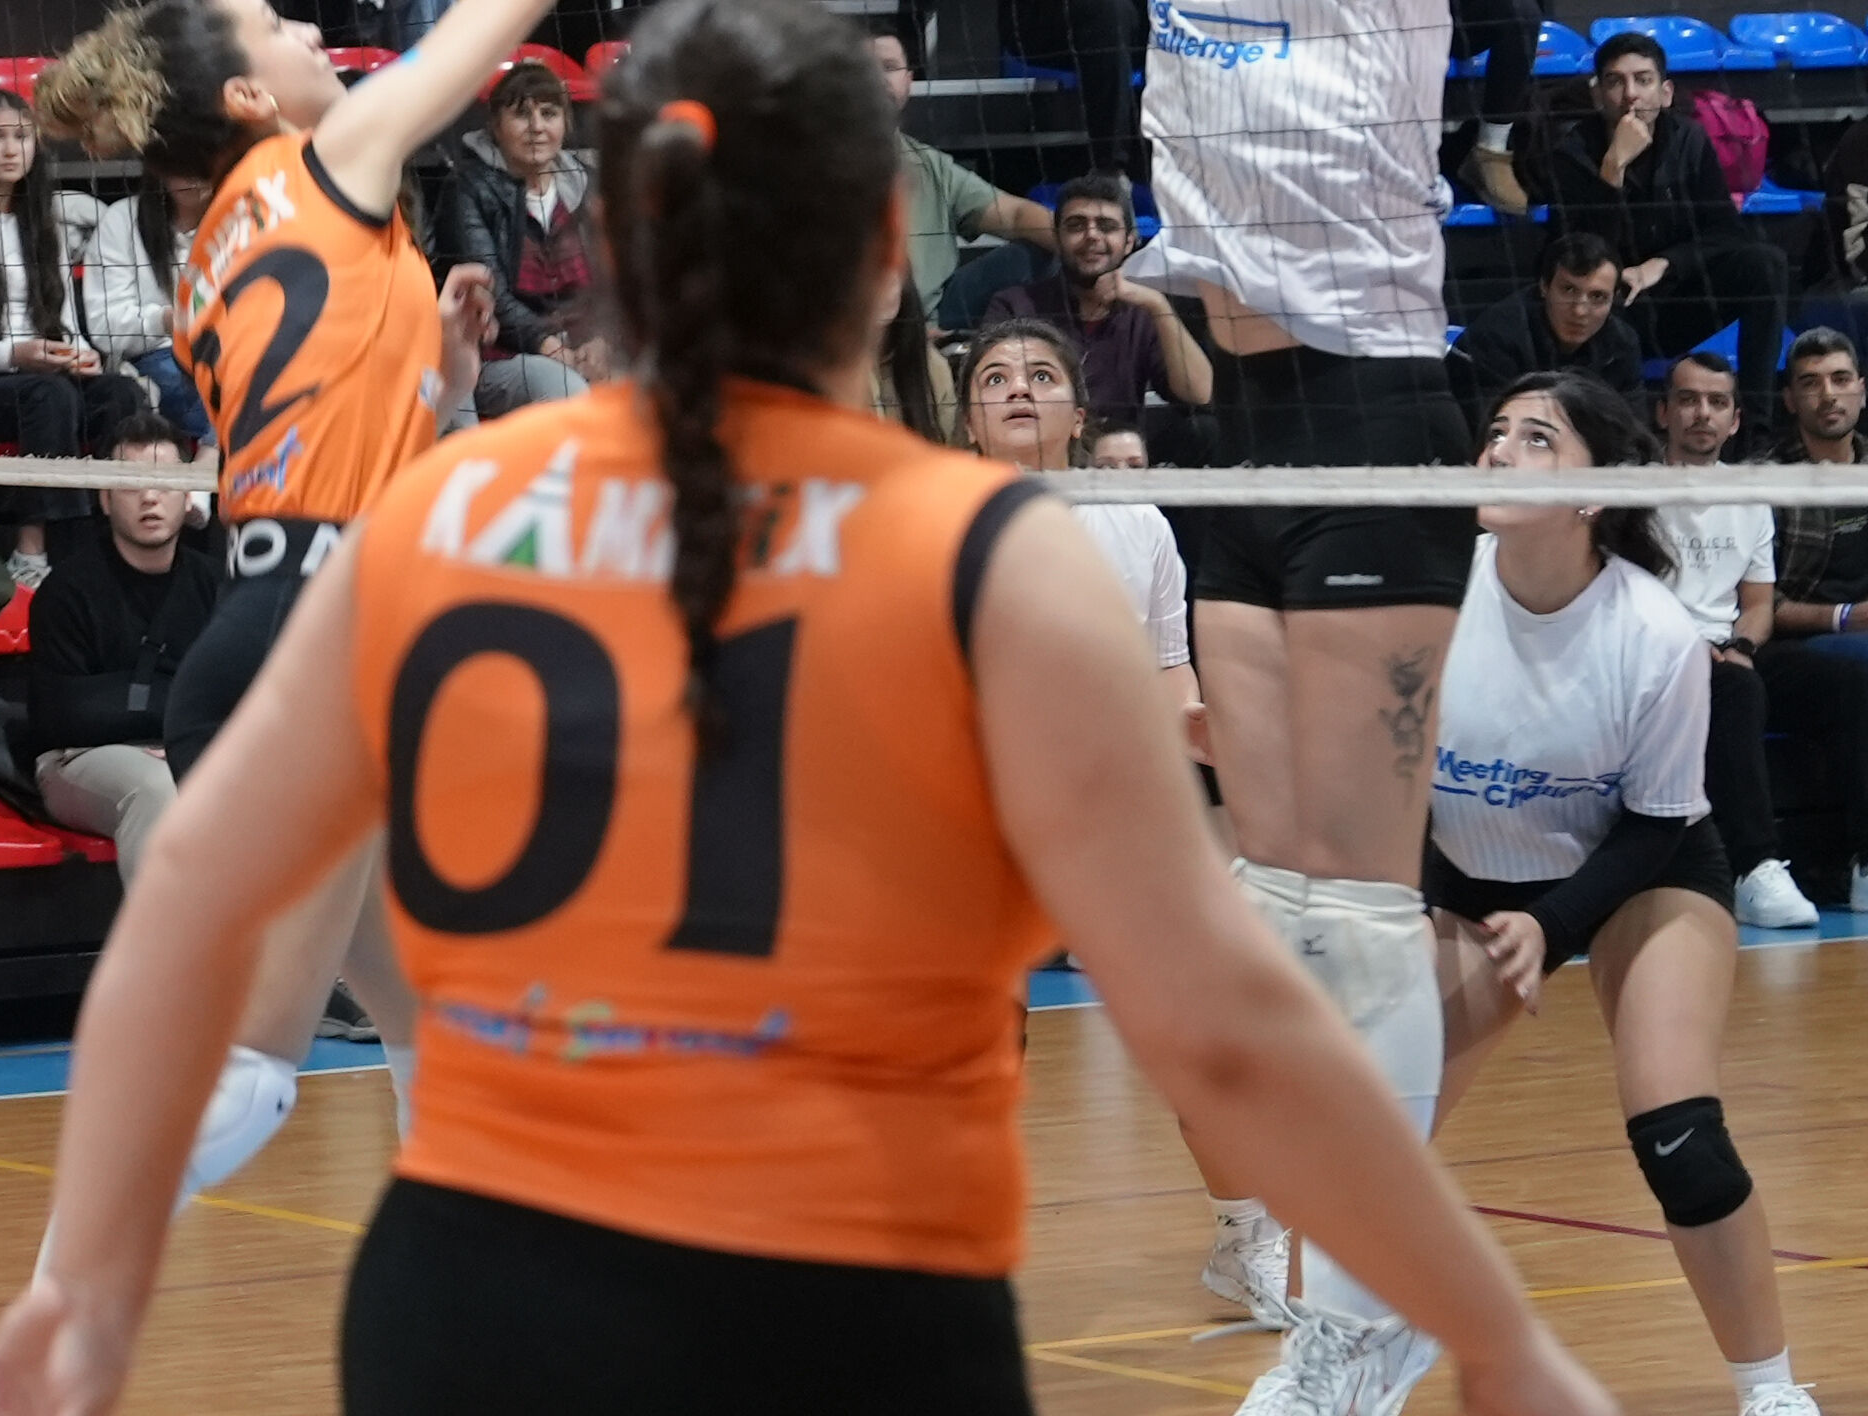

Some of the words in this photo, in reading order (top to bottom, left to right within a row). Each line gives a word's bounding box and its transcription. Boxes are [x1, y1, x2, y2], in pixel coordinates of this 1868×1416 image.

[1152, 27, 1264, 69] allenge
[388, 601, 799, 958] 01
[1436, 745, 1553, 785] Meeting
